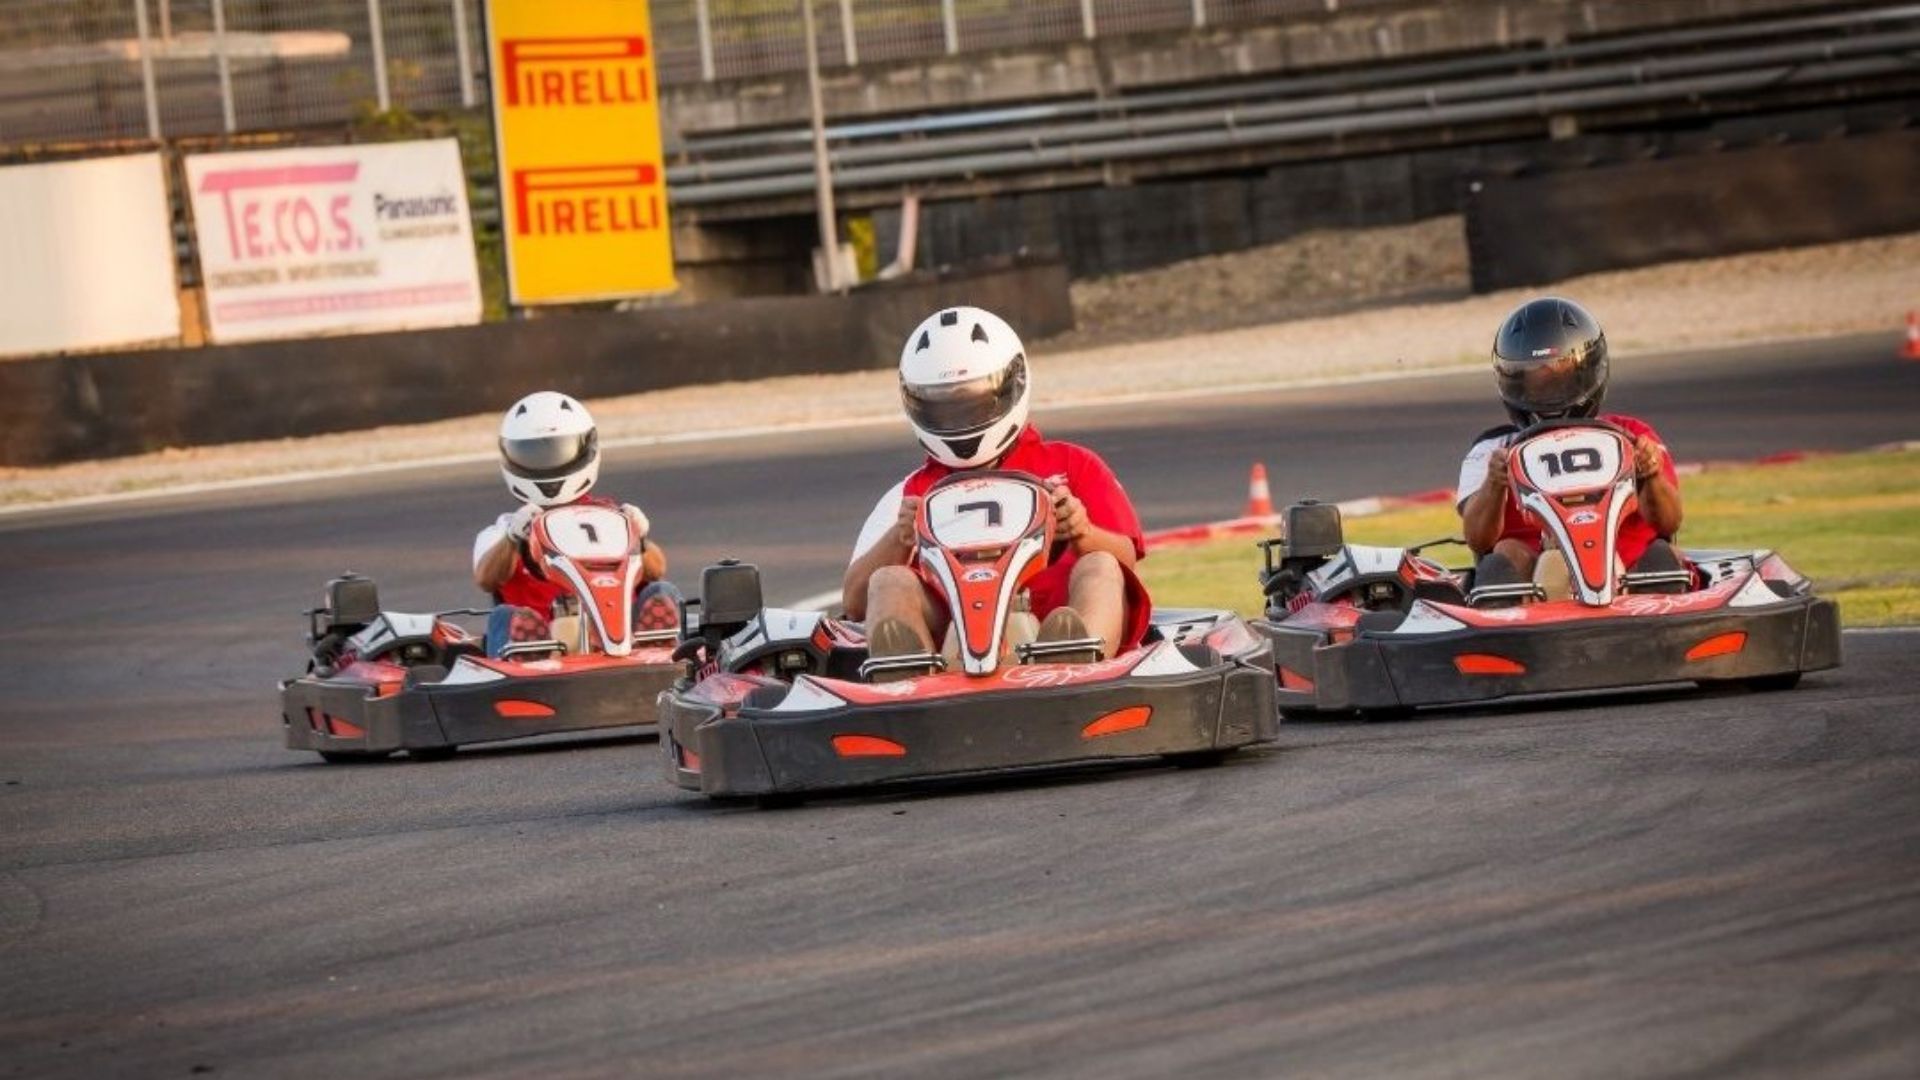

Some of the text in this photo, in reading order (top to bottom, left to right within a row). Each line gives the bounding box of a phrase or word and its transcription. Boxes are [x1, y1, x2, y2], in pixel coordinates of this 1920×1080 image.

[503, 36, 649, 107] PIRELLI
[374, 192, 458, 219] Panasonic
[513, 164, 660, 235] PIRELLI
[1539, 447, 1602, 478] 10
[957, 501, 1001, 527] 7
[579, 523, 599, 543] 1
